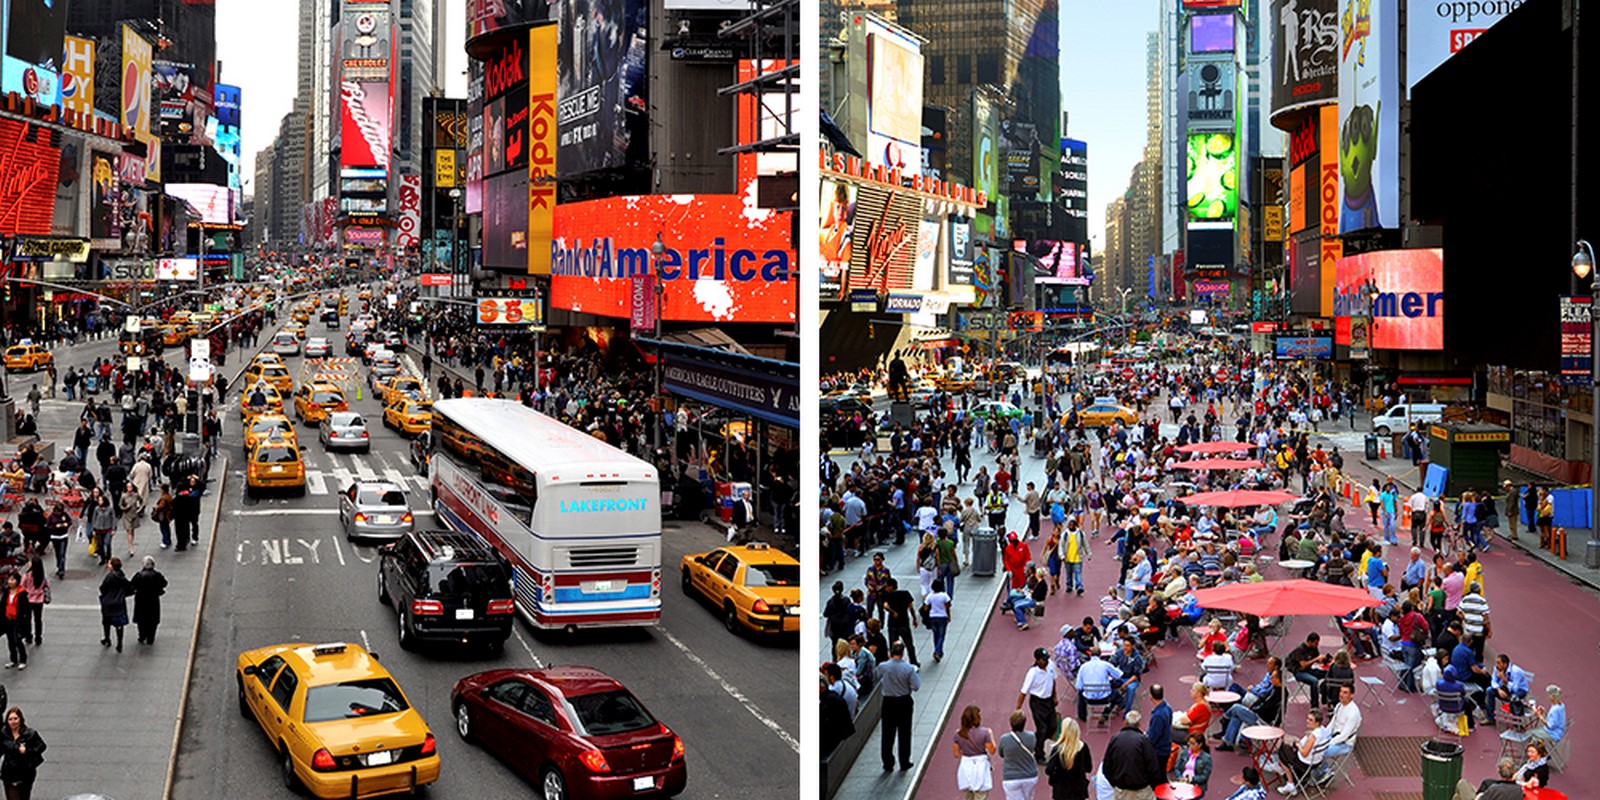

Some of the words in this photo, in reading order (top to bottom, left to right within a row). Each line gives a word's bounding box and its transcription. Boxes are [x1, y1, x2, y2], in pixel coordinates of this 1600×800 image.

[1455, 33, 1483, 49] SP
[343, 59, 387, 67] CHEVROLET
[485, 39, 525, 100] Kodak
[1292, 82, 1321, 96] 2009
[531, 93, 554, 211] Kodak
[912, 174, 987, 205] BUILDING
[1322, 162, 1341, 263] Kodak
[551, 239, 580, 276] Bank
[584, 238, 599, 277] of
[599, 237, 789, 281] America
[633, 277, 644, 327] WELCOME
[888, 298, 921, 309] VORNADO
[1561, 307, 1591, 318] FLEA
[665, 366, 697, 383] AMERICAN
[696, 372, 718, 391] EAGLE
[719, 378, 766, 403] OUTFITTERS
[560, 498, 647, 513] LAKEFRONT
[236, 538, 321, 565] ONLY
